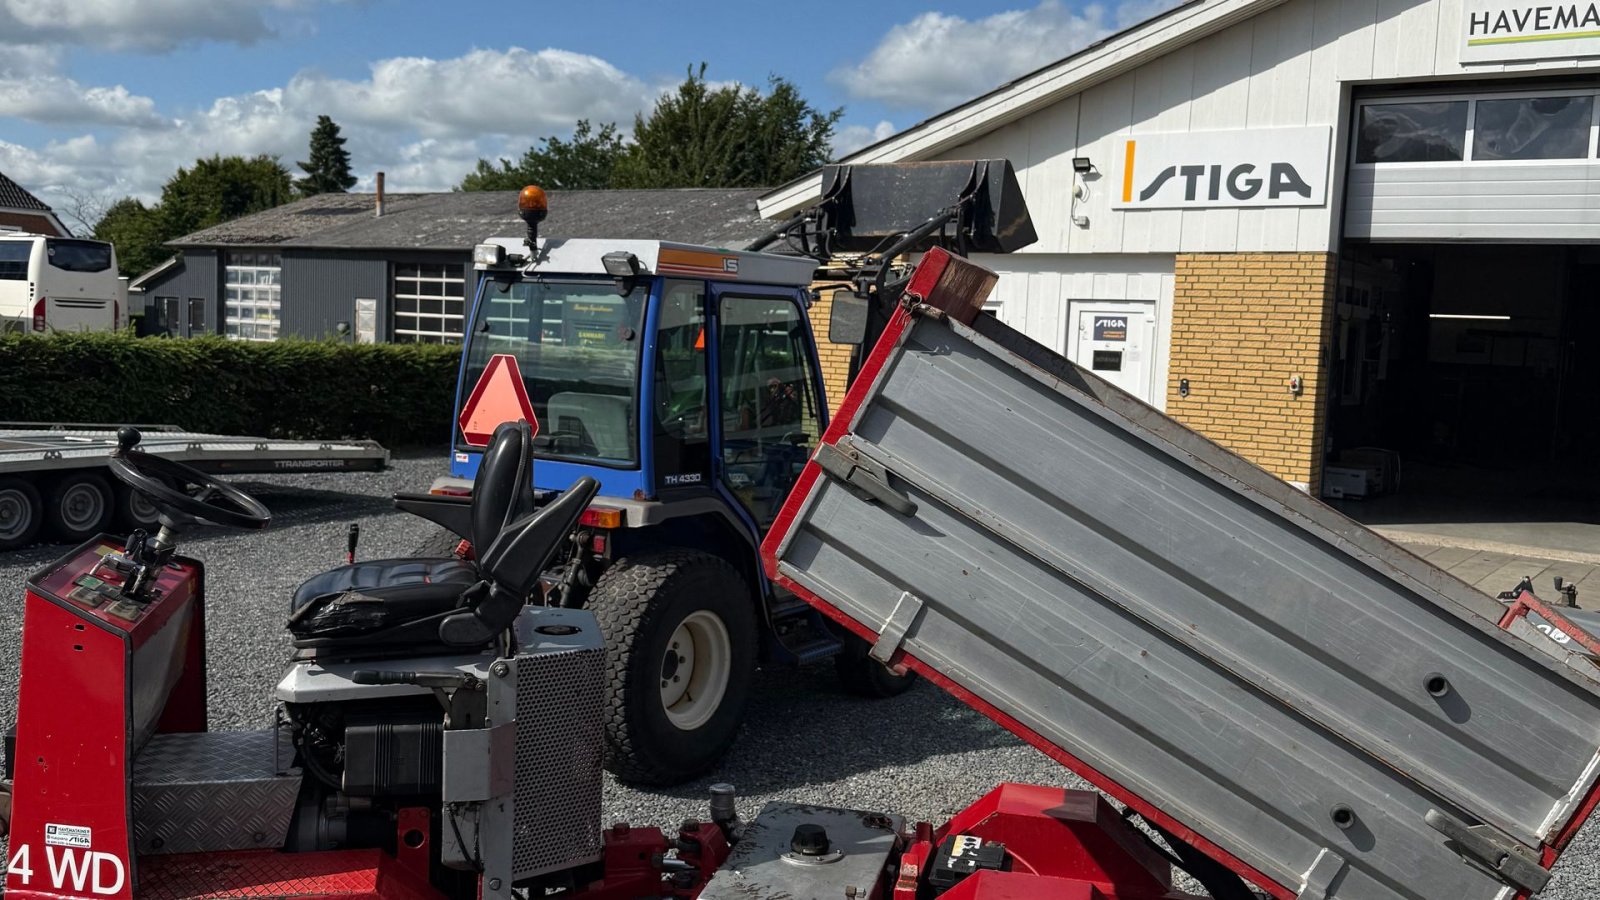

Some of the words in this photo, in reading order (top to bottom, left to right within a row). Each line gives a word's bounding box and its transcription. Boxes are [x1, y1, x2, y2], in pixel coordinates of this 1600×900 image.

[1139, 162, 1312, 201] STIGA
[1096, 320, 1125, 328] STIGA
[664, 475, 678, 484] TH
[679, 473, 701, 483] 4330
[8, 844, 34, 885] 4
[45, 845, 125, 895] WD
